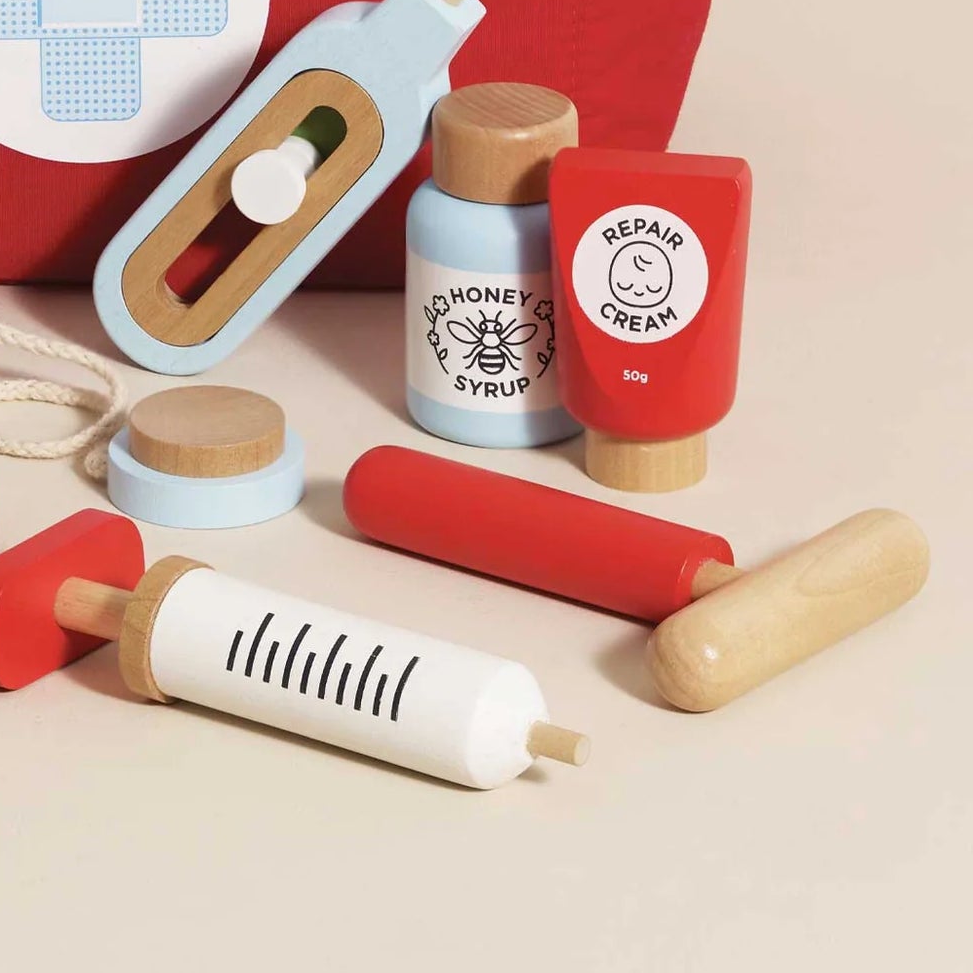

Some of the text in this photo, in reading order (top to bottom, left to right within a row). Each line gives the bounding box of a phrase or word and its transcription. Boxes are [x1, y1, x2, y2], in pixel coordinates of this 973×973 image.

[602, 218, 684, 251] REPAIR
[450, 287, 533, 307] HONEY
[600, 303, 678, 333] CREAM
[454, 375, 530, 398] SYRUP
[623, 370, 648, 383] 50g
